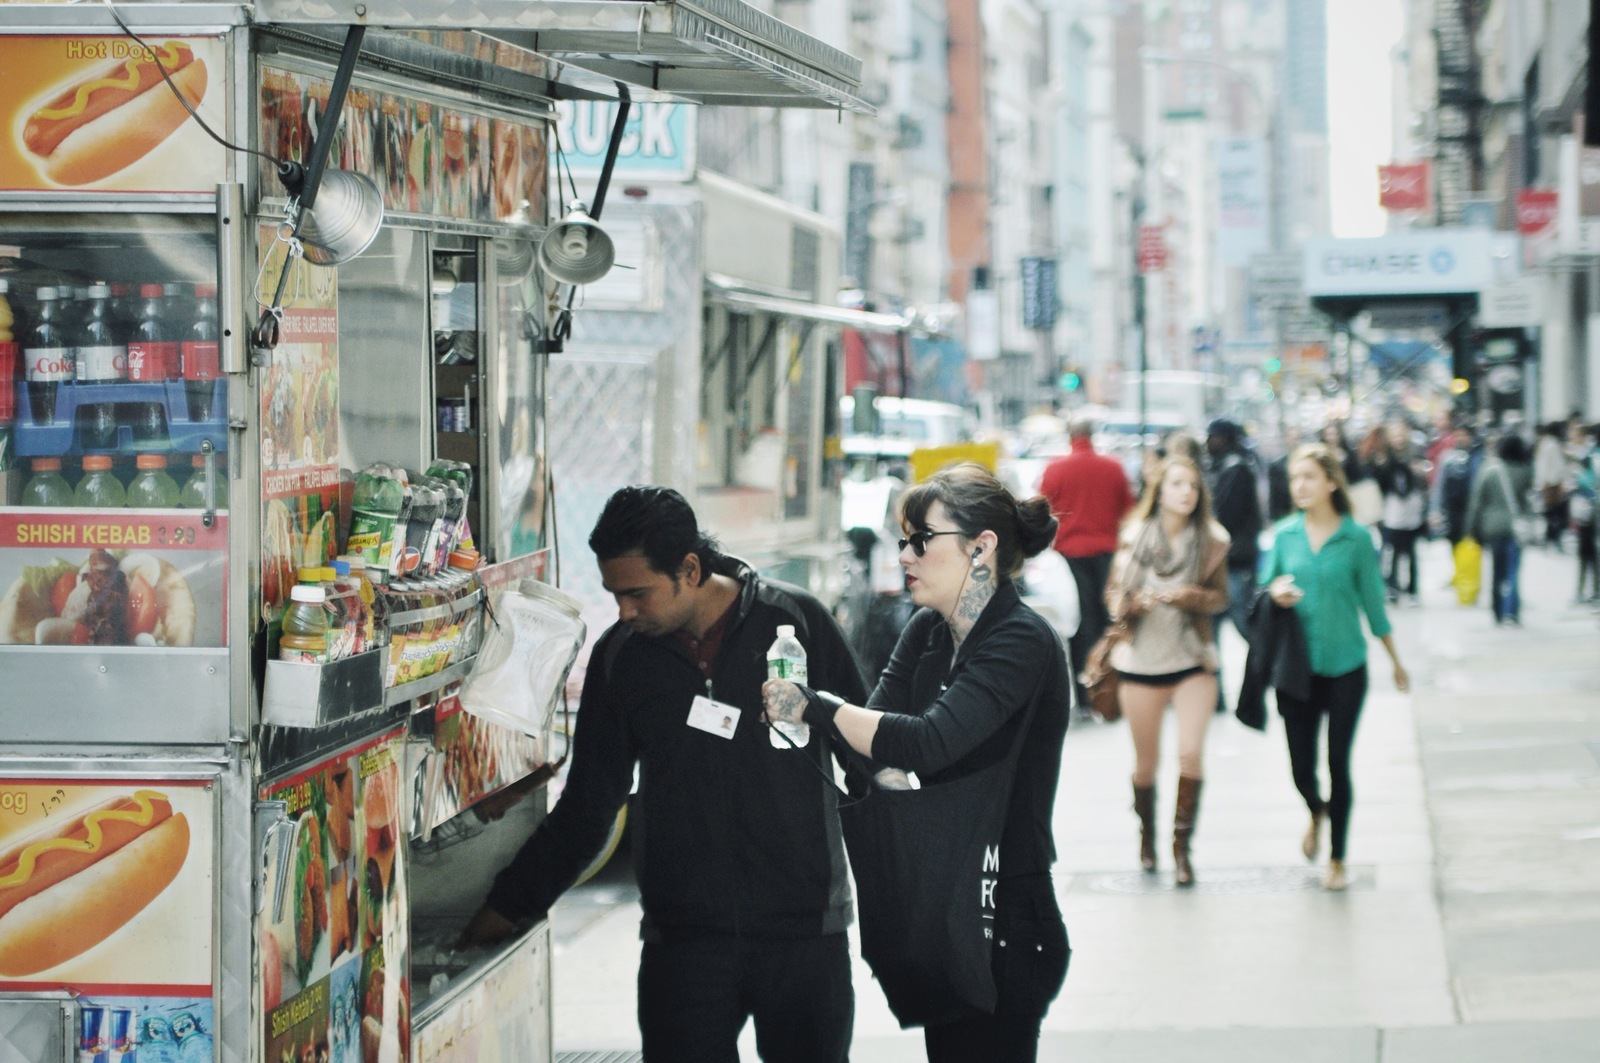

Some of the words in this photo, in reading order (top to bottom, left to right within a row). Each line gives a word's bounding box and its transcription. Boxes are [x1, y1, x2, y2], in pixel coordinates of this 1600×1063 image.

[67, 41, 106, 59] Hot
[112, 41, 156, 63] Dog
[17, 523, 76, 543] SHISH
[82, 525, 151, 544] KEBAB
